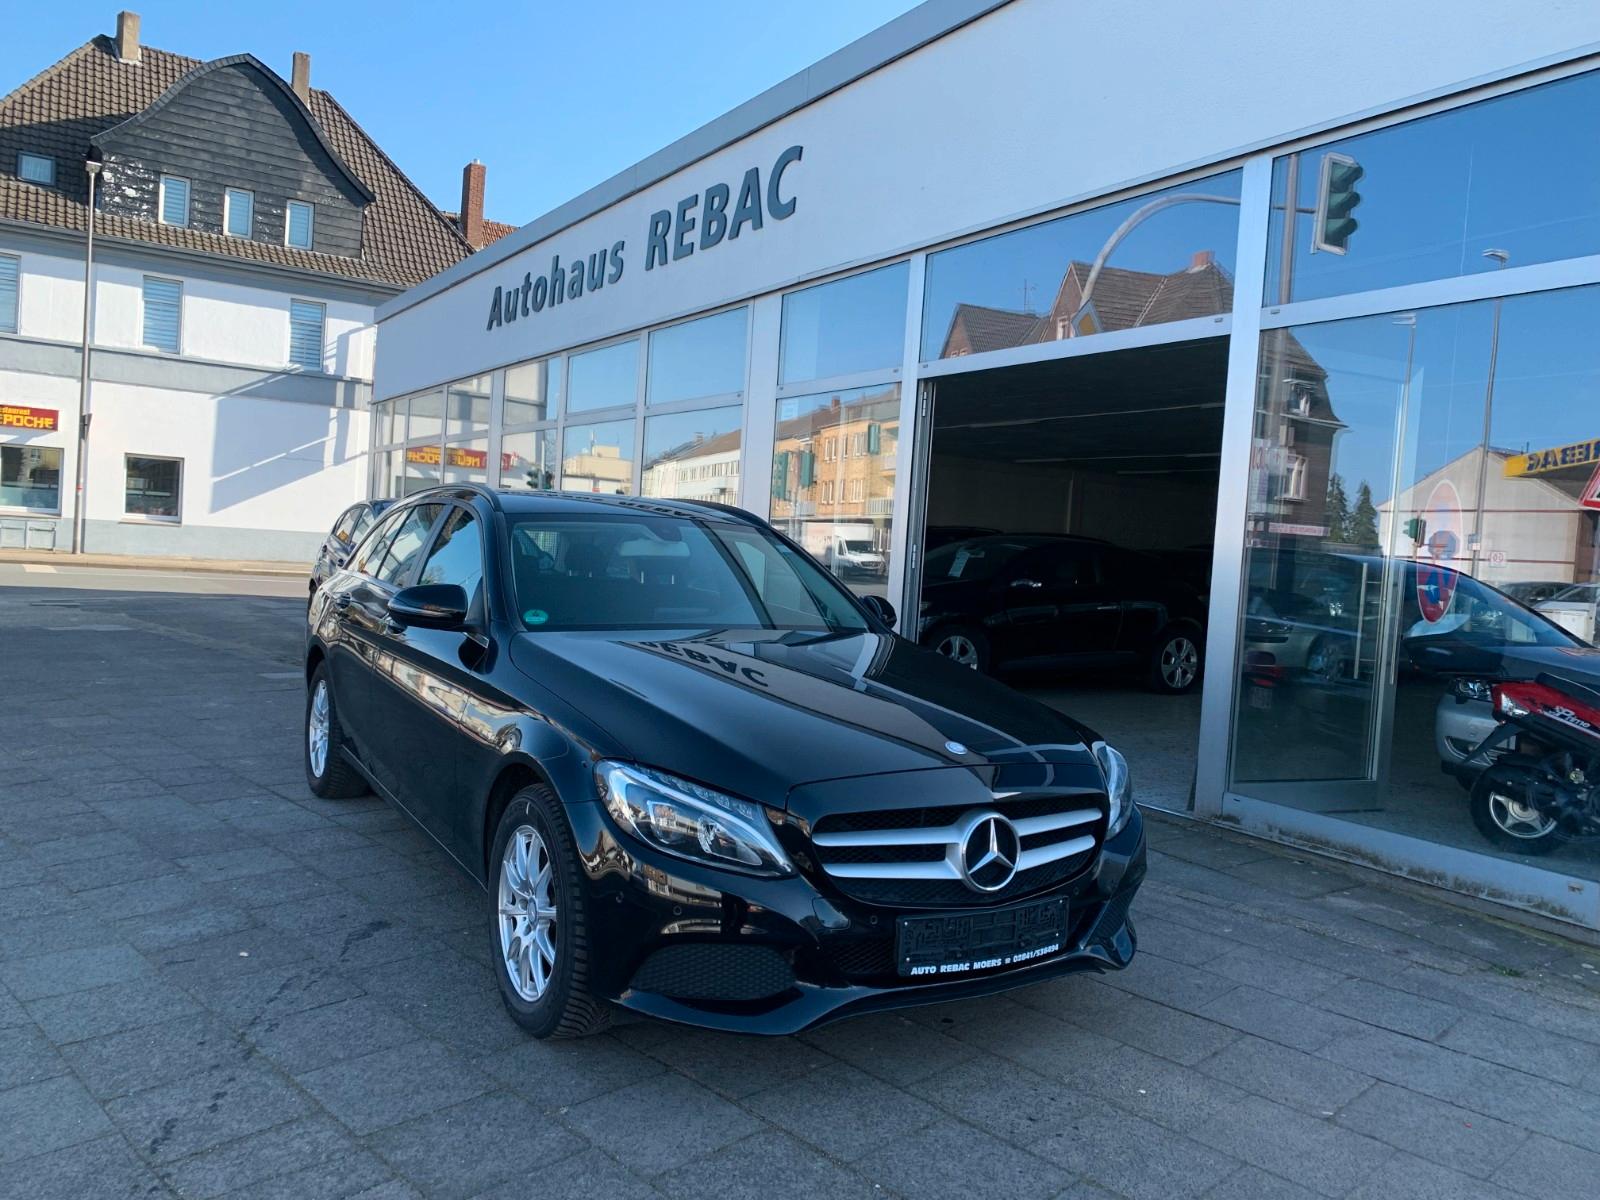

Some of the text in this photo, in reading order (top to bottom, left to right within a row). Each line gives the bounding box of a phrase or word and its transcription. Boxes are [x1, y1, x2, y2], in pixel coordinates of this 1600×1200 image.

[486, 145, 804, 331] Autohaus REBAC
[910, 965, 937, 976] AUTO
[940, 963, 970, 974] REBAC
[973, 958, 1002, 970] MOERS
